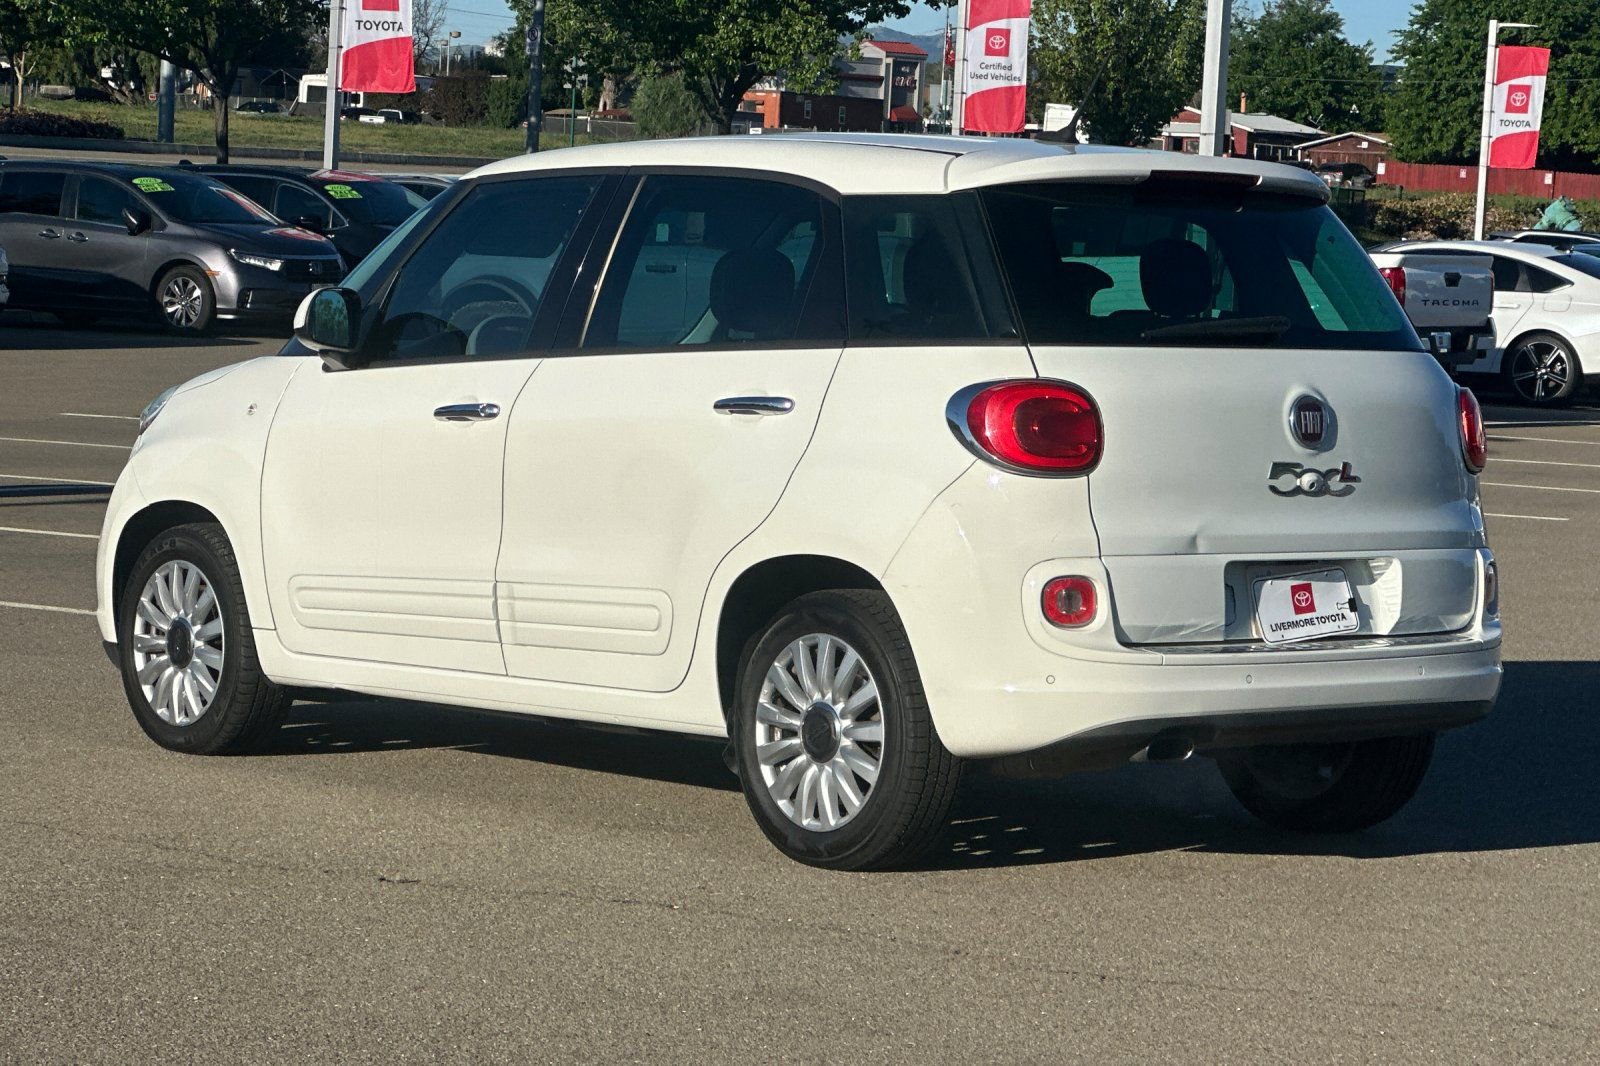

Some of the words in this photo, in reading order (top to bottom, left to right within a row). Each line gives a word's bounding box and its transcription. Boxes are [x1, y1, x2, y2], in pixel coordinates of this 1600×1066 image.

[355, 20, 404, 32] TOYOTA
[979, 62, 1013, 71] Certified
[969, 71, 989, 80] Used
[990, 73, 1022, 82] Vehicles
[1500, 119, 1531, 128] TOYOTA
[1421, 299, 1479, 307] TACOMA
[1300, 411, 1321, 434] FIAT
[1270, 618, 1316, 633] LIVERMORE
[1315, 612, 1347, 625] TOYOTA
